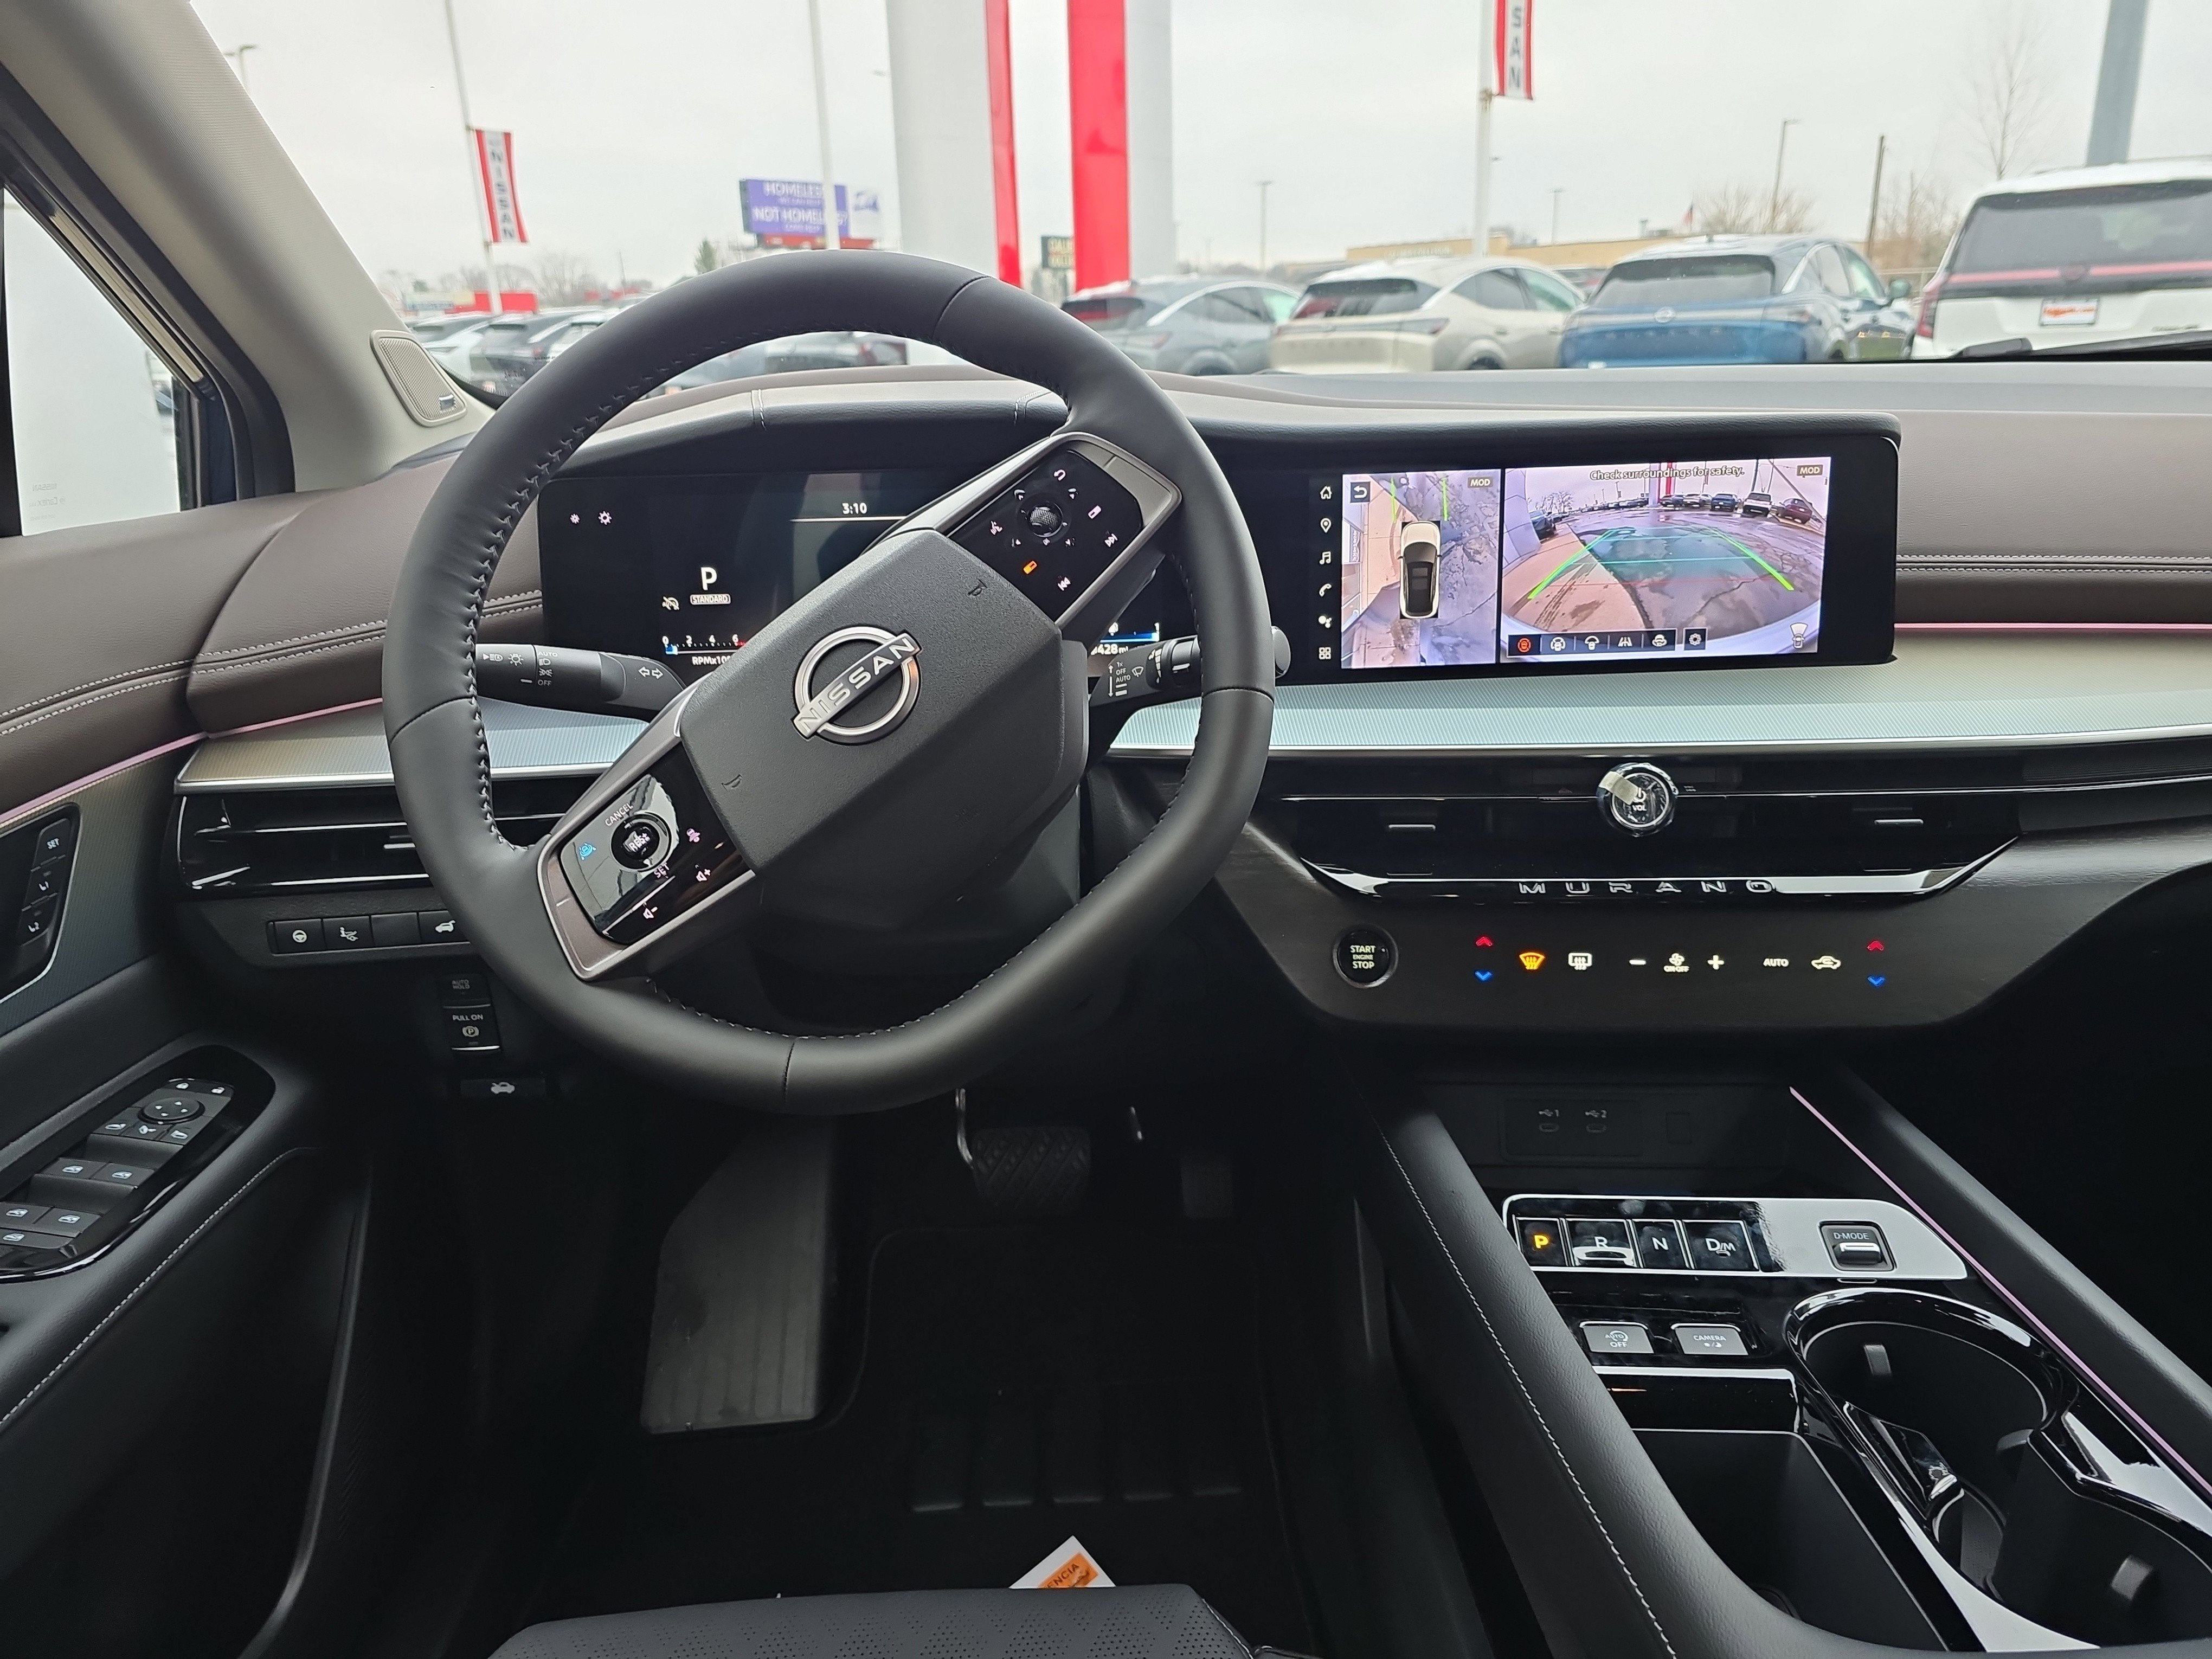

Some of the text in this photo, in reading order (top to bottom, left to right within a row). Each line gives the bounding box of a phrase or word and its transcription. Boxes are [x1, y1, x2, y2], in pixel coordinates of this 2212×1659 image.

[491, 149, 515, 238] NISSAN
[1590, 466, 1745, 480] Check surroundings for safety.
[1799, 466, 1821, 474] MOD
[1470, 478, 1491, 487] MOD
[842, 502, 867, 515] 3:10
[700, 567, 717, 591] P
[692, 595, 728, 603] STANDARD
[662, 634, 738, 644] 0 2 4 6
[1115, 667, 1127, 676] OFF
[798, 637, 916, 732] NISSAN
[1115, 674, 1131, 683] AUTO
[605, 802, 634, 827] CANCEL
[47, 838, 60, 850] SET
[654, 862, 670, 878] SET
[1518, 880, 1775, 893] MURANO
[1349, 945, 1377, 953] START
[1352, 961, 1375, 969] STOP
[1763, 958, 1789, 967] AUTO
[1534, 1234, 1549, 1249] P
[1594, 1236, 1608, 1248] R
[1652, 1237, 1669, 1251] N
